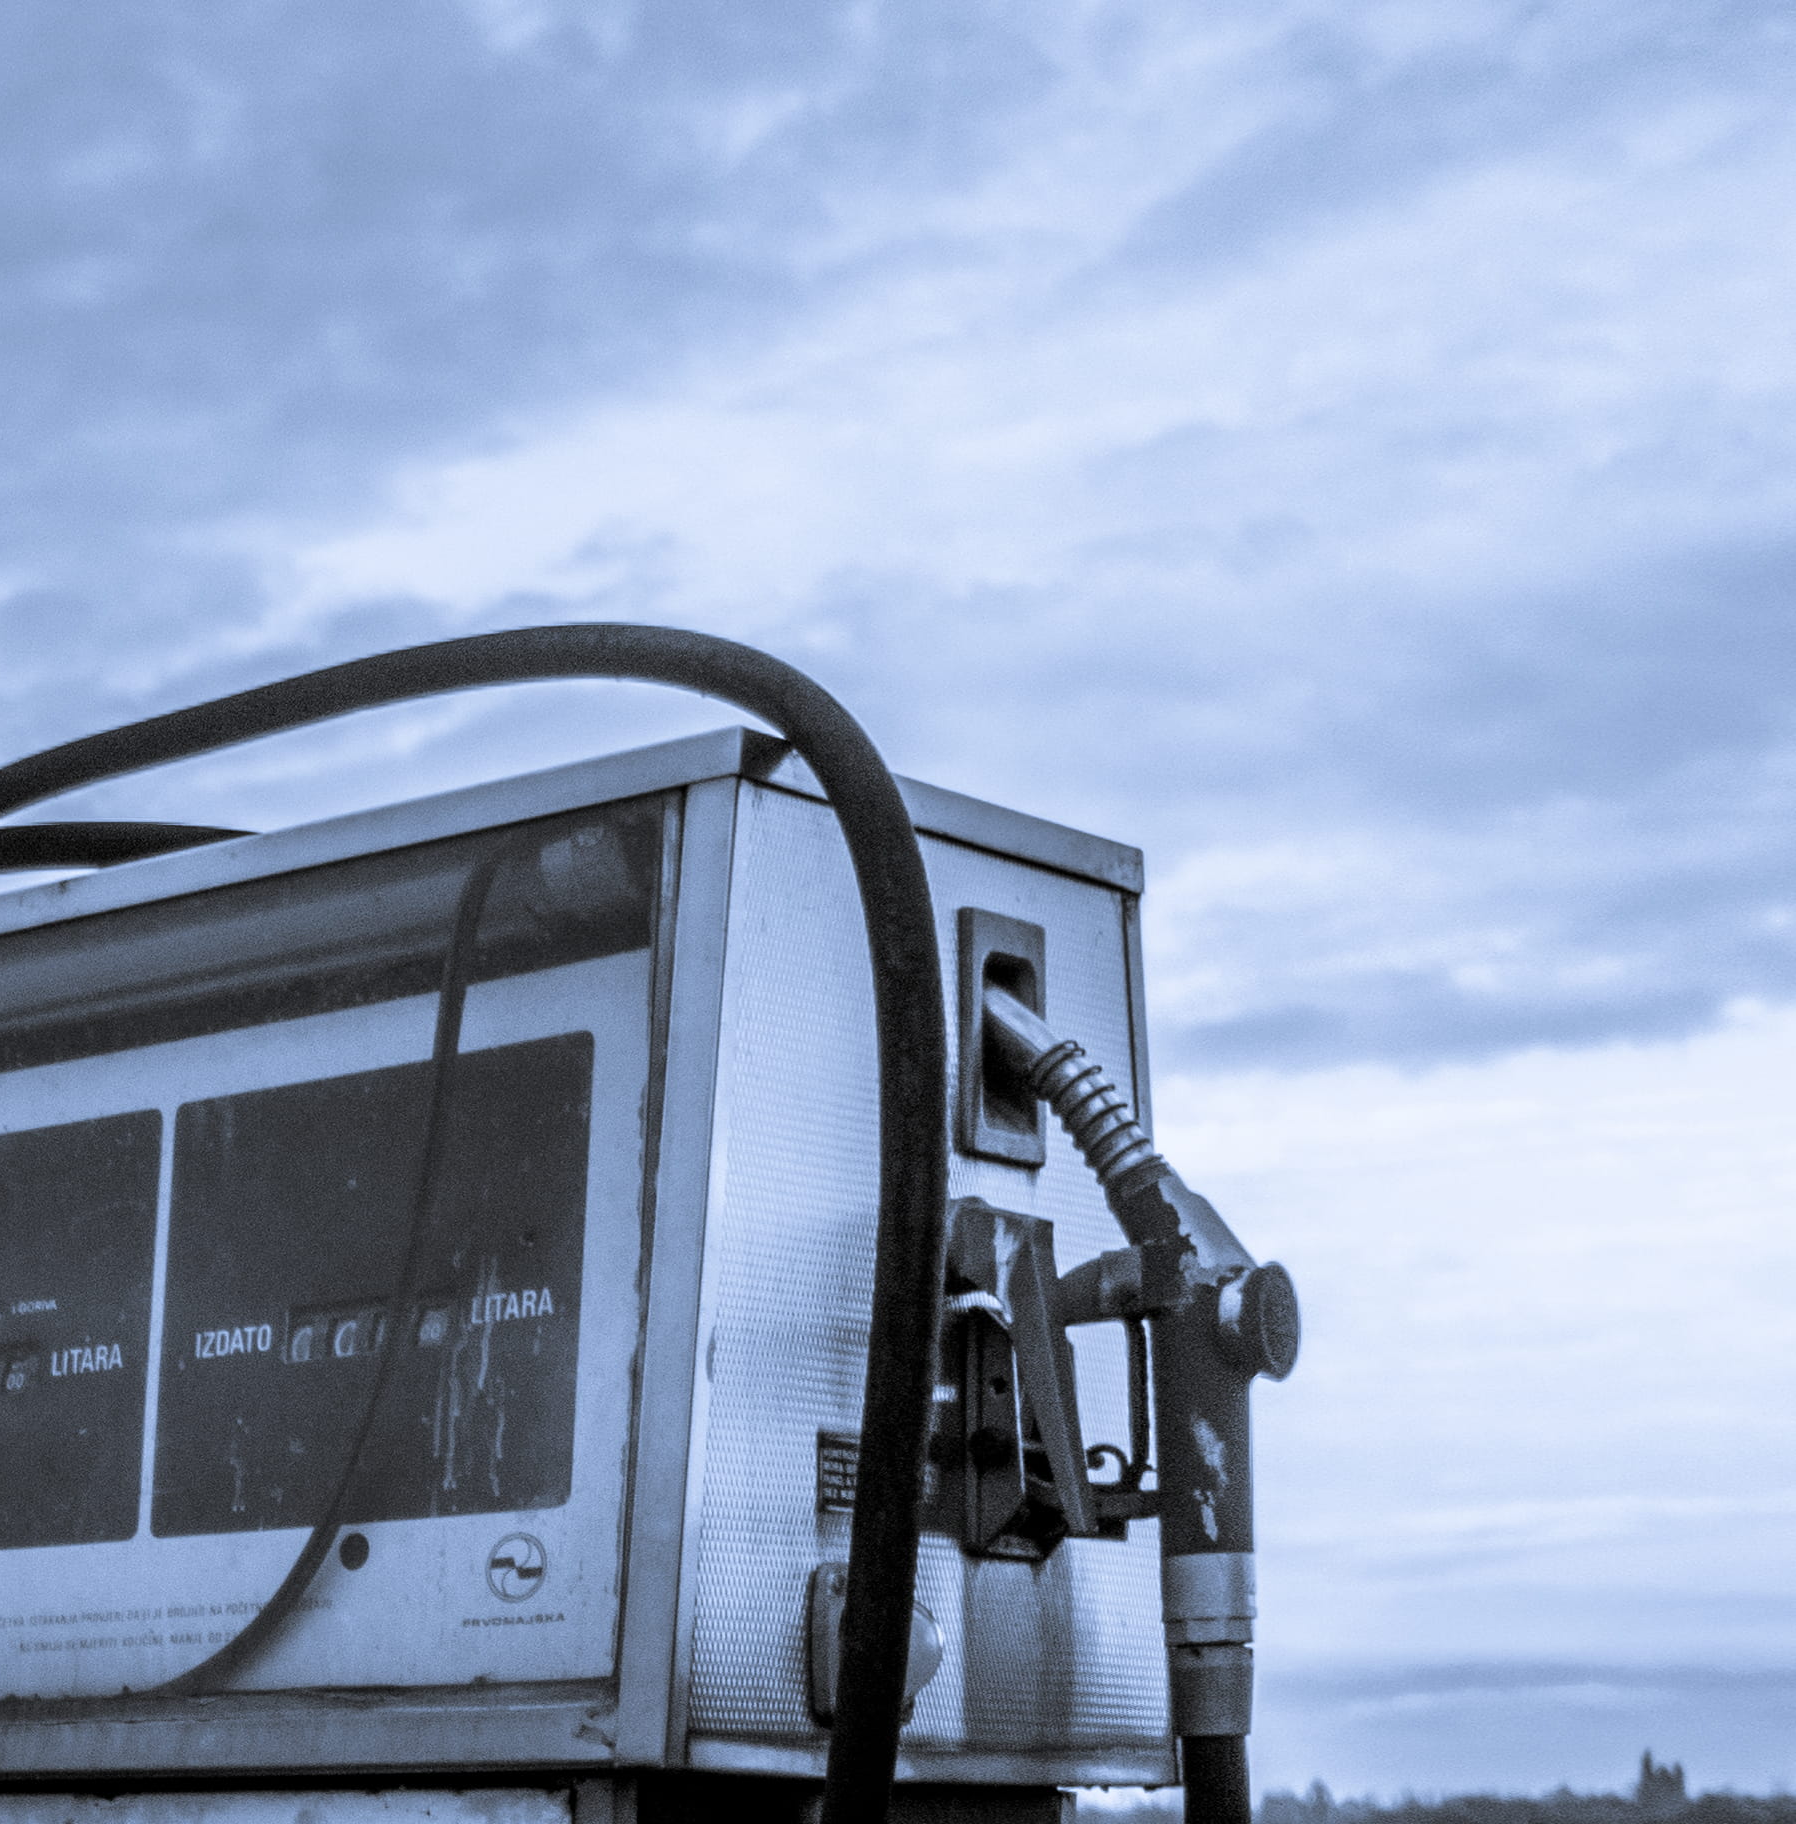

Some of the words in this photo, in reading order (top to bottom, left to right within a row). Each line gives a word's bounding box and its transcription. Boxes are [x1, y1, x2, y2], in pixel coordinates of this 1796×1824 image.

[195, 1323, 272, 1359] IZDATO
[471, 1287, 554, 1325] LITARA
[51, 1343, 124, 1378] LITARA
